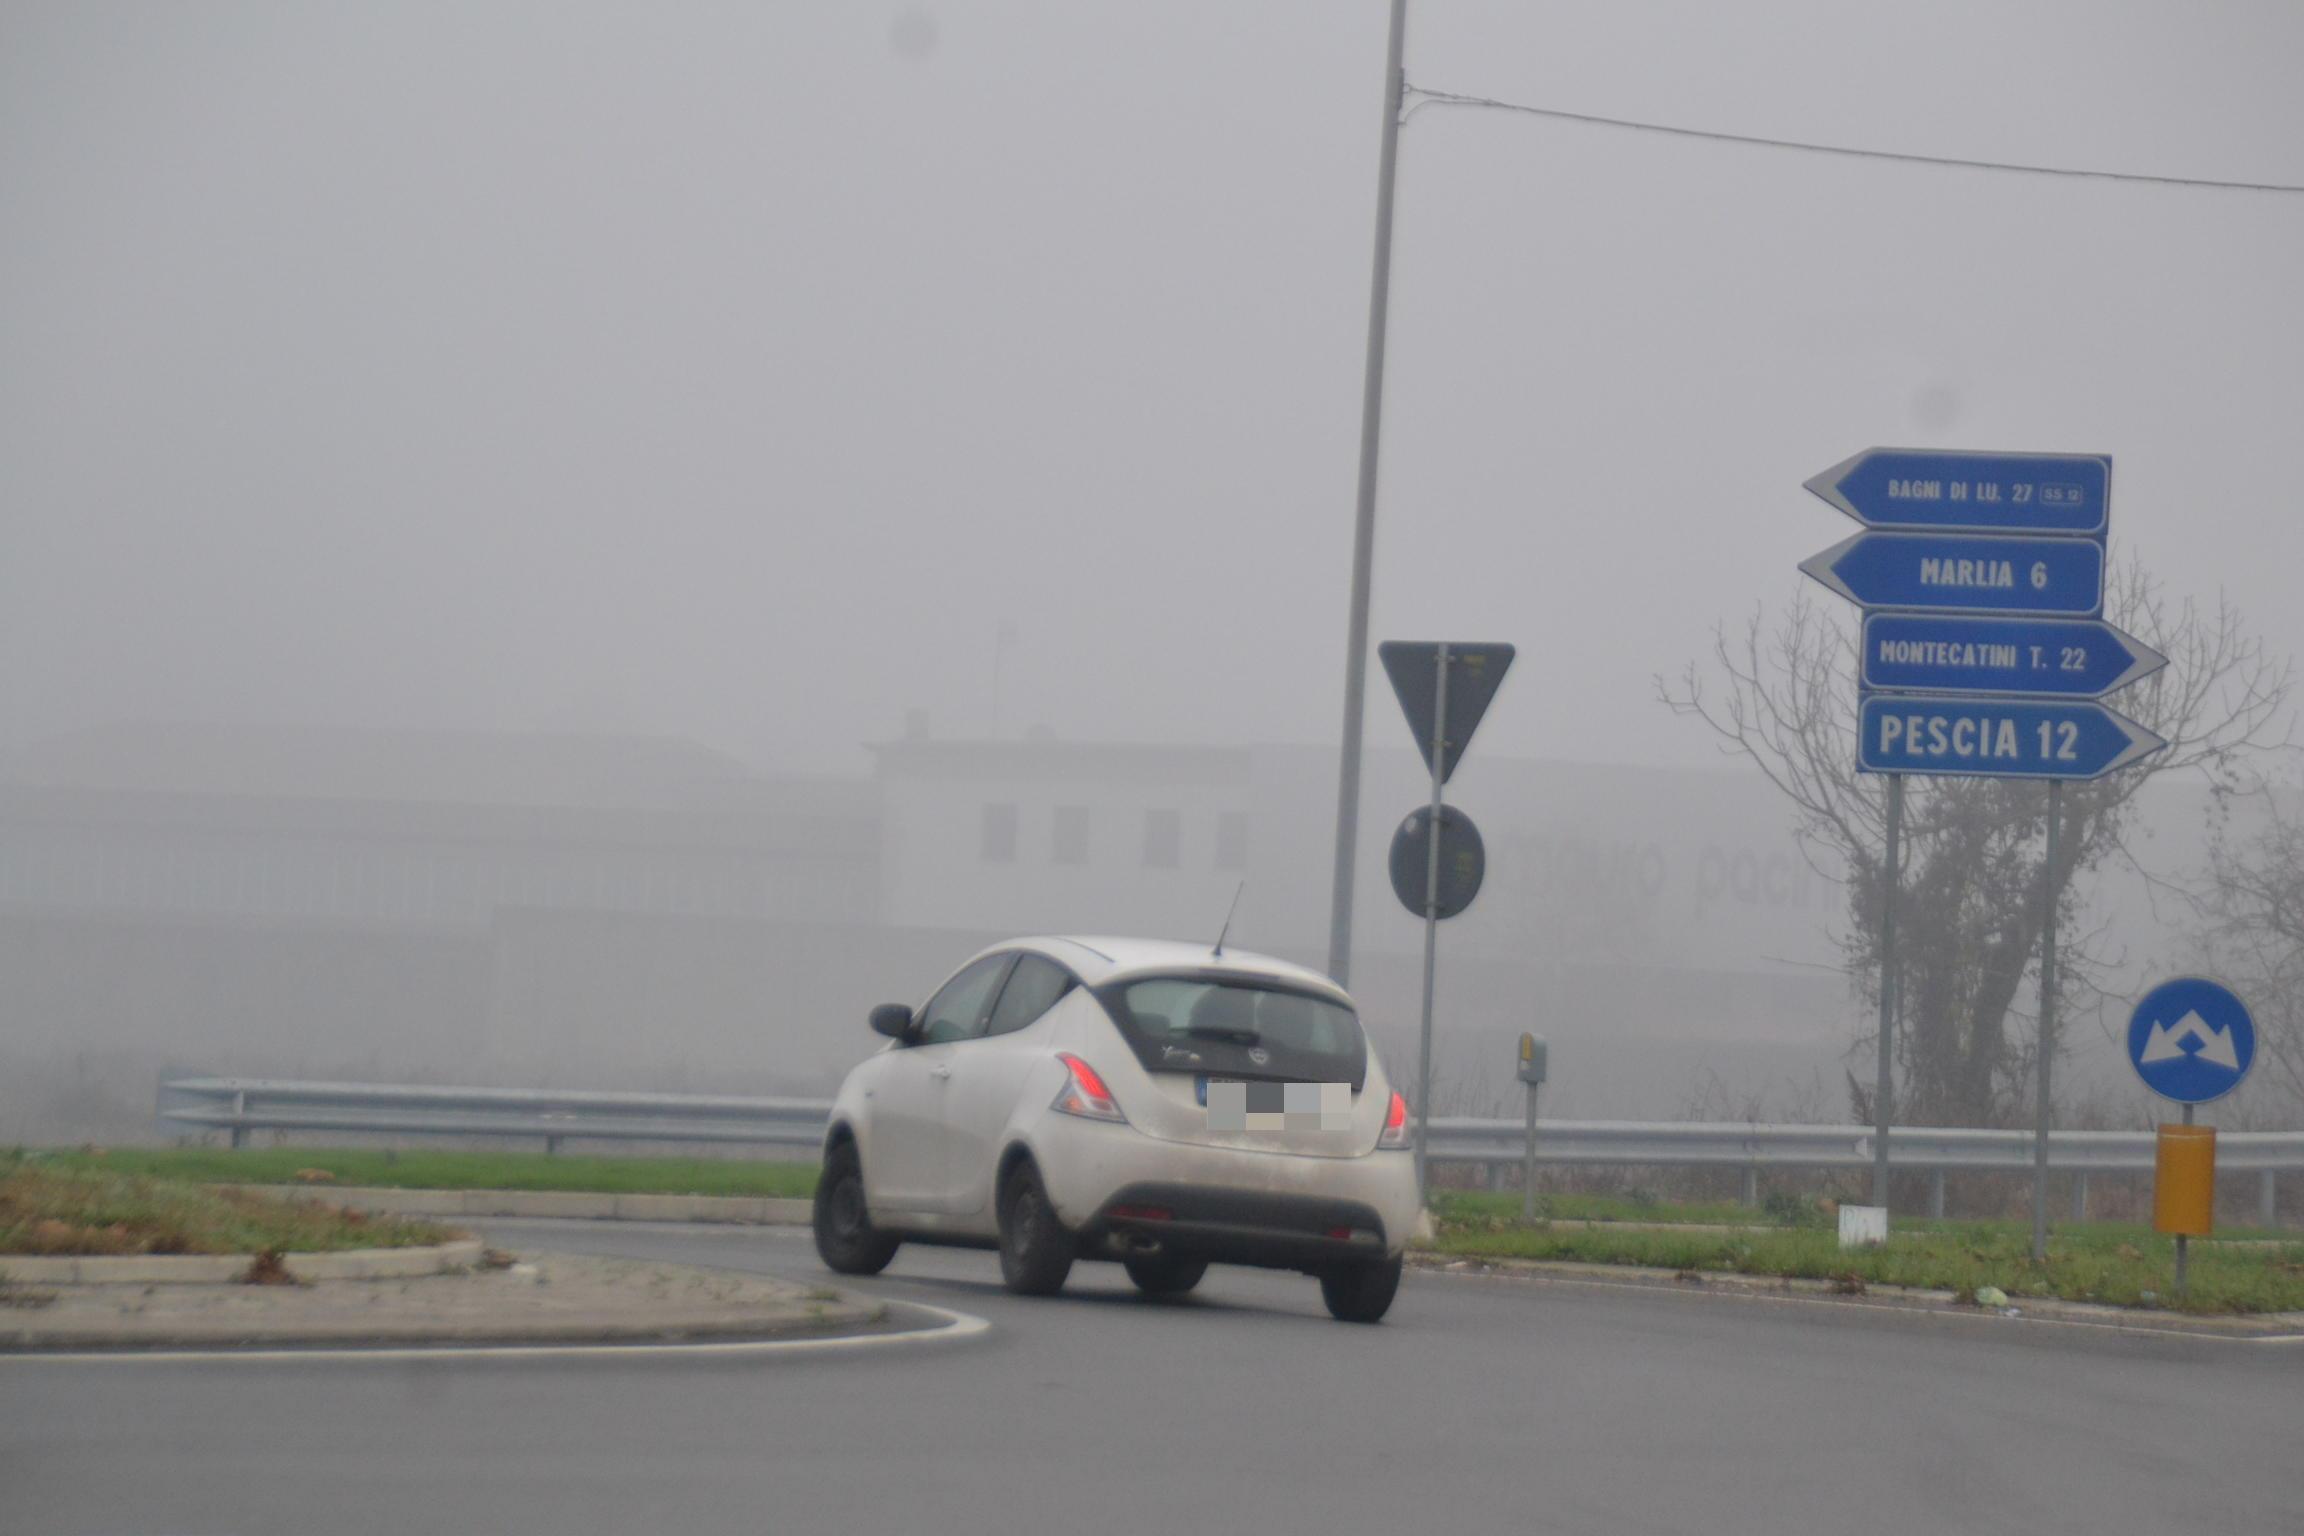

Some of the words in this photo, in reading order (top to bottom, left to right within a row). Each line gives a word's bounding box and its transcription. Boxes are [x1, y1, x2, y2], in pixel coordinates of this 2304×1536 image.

[1888, 479, 1940, 499] BAGNI
[1950, 482, 1967, 499] DI
[1977, 483, 2001, 501] LU.
[2012, 484, 2033, 501] 27
[1920, 558, 2013, 587] MARLIA
[2030, 561, 2047, 588] 6
[1880, 640, 2016, 668] MONTECATINI
[2030, 646, 2048, 669] T.
[2060, 648, 2086, 670] 22
[1880, 715, 2017, 758] PESCIA
[2037, 720, 2079, 760] 12
